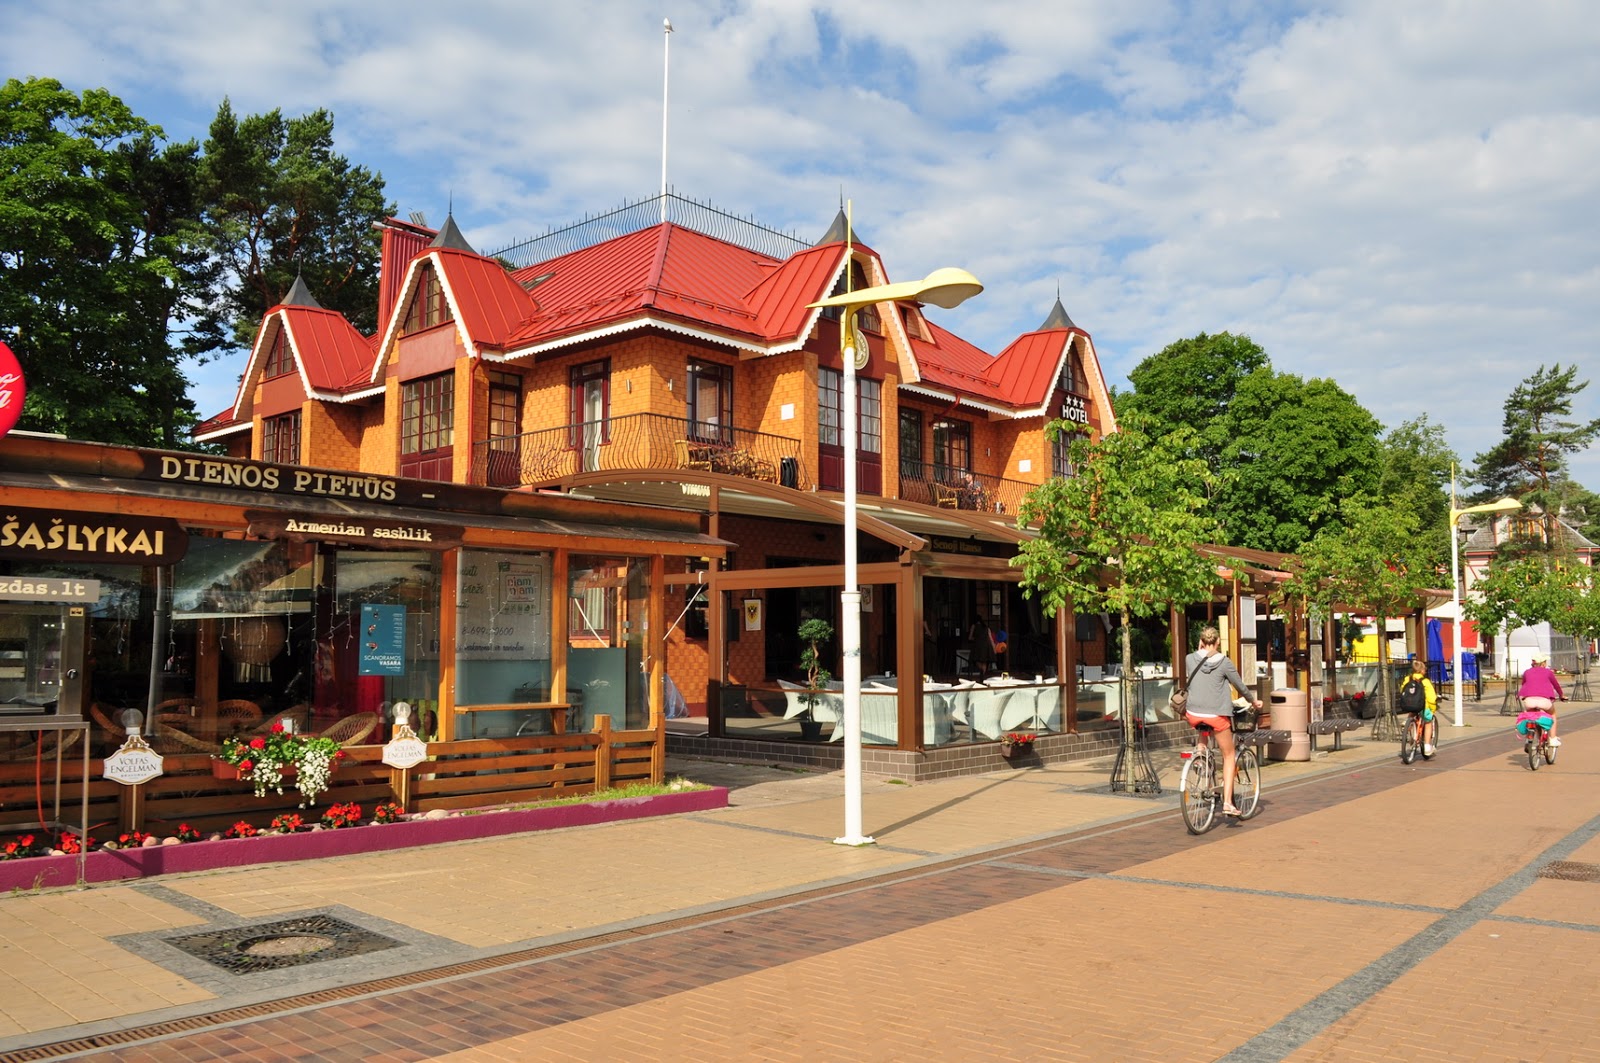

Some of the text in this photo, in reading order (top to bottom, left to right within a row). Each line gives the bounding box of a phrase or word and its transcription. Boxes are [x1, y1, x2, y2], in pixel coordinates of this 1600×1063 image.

[1062, 405, 1089, 425] HOTEL
[160, 456, 280, 489] DIENOS
[293, 470, 396, 500] PIETŪS
[1, 515, 164, 556] ŠAŠLYKAI
[286, 519, 432, 542] Armenian sashlik
[110, 763, 157, 773] ENGELMAN
[120, 757, 148, 765] VOLFAS
